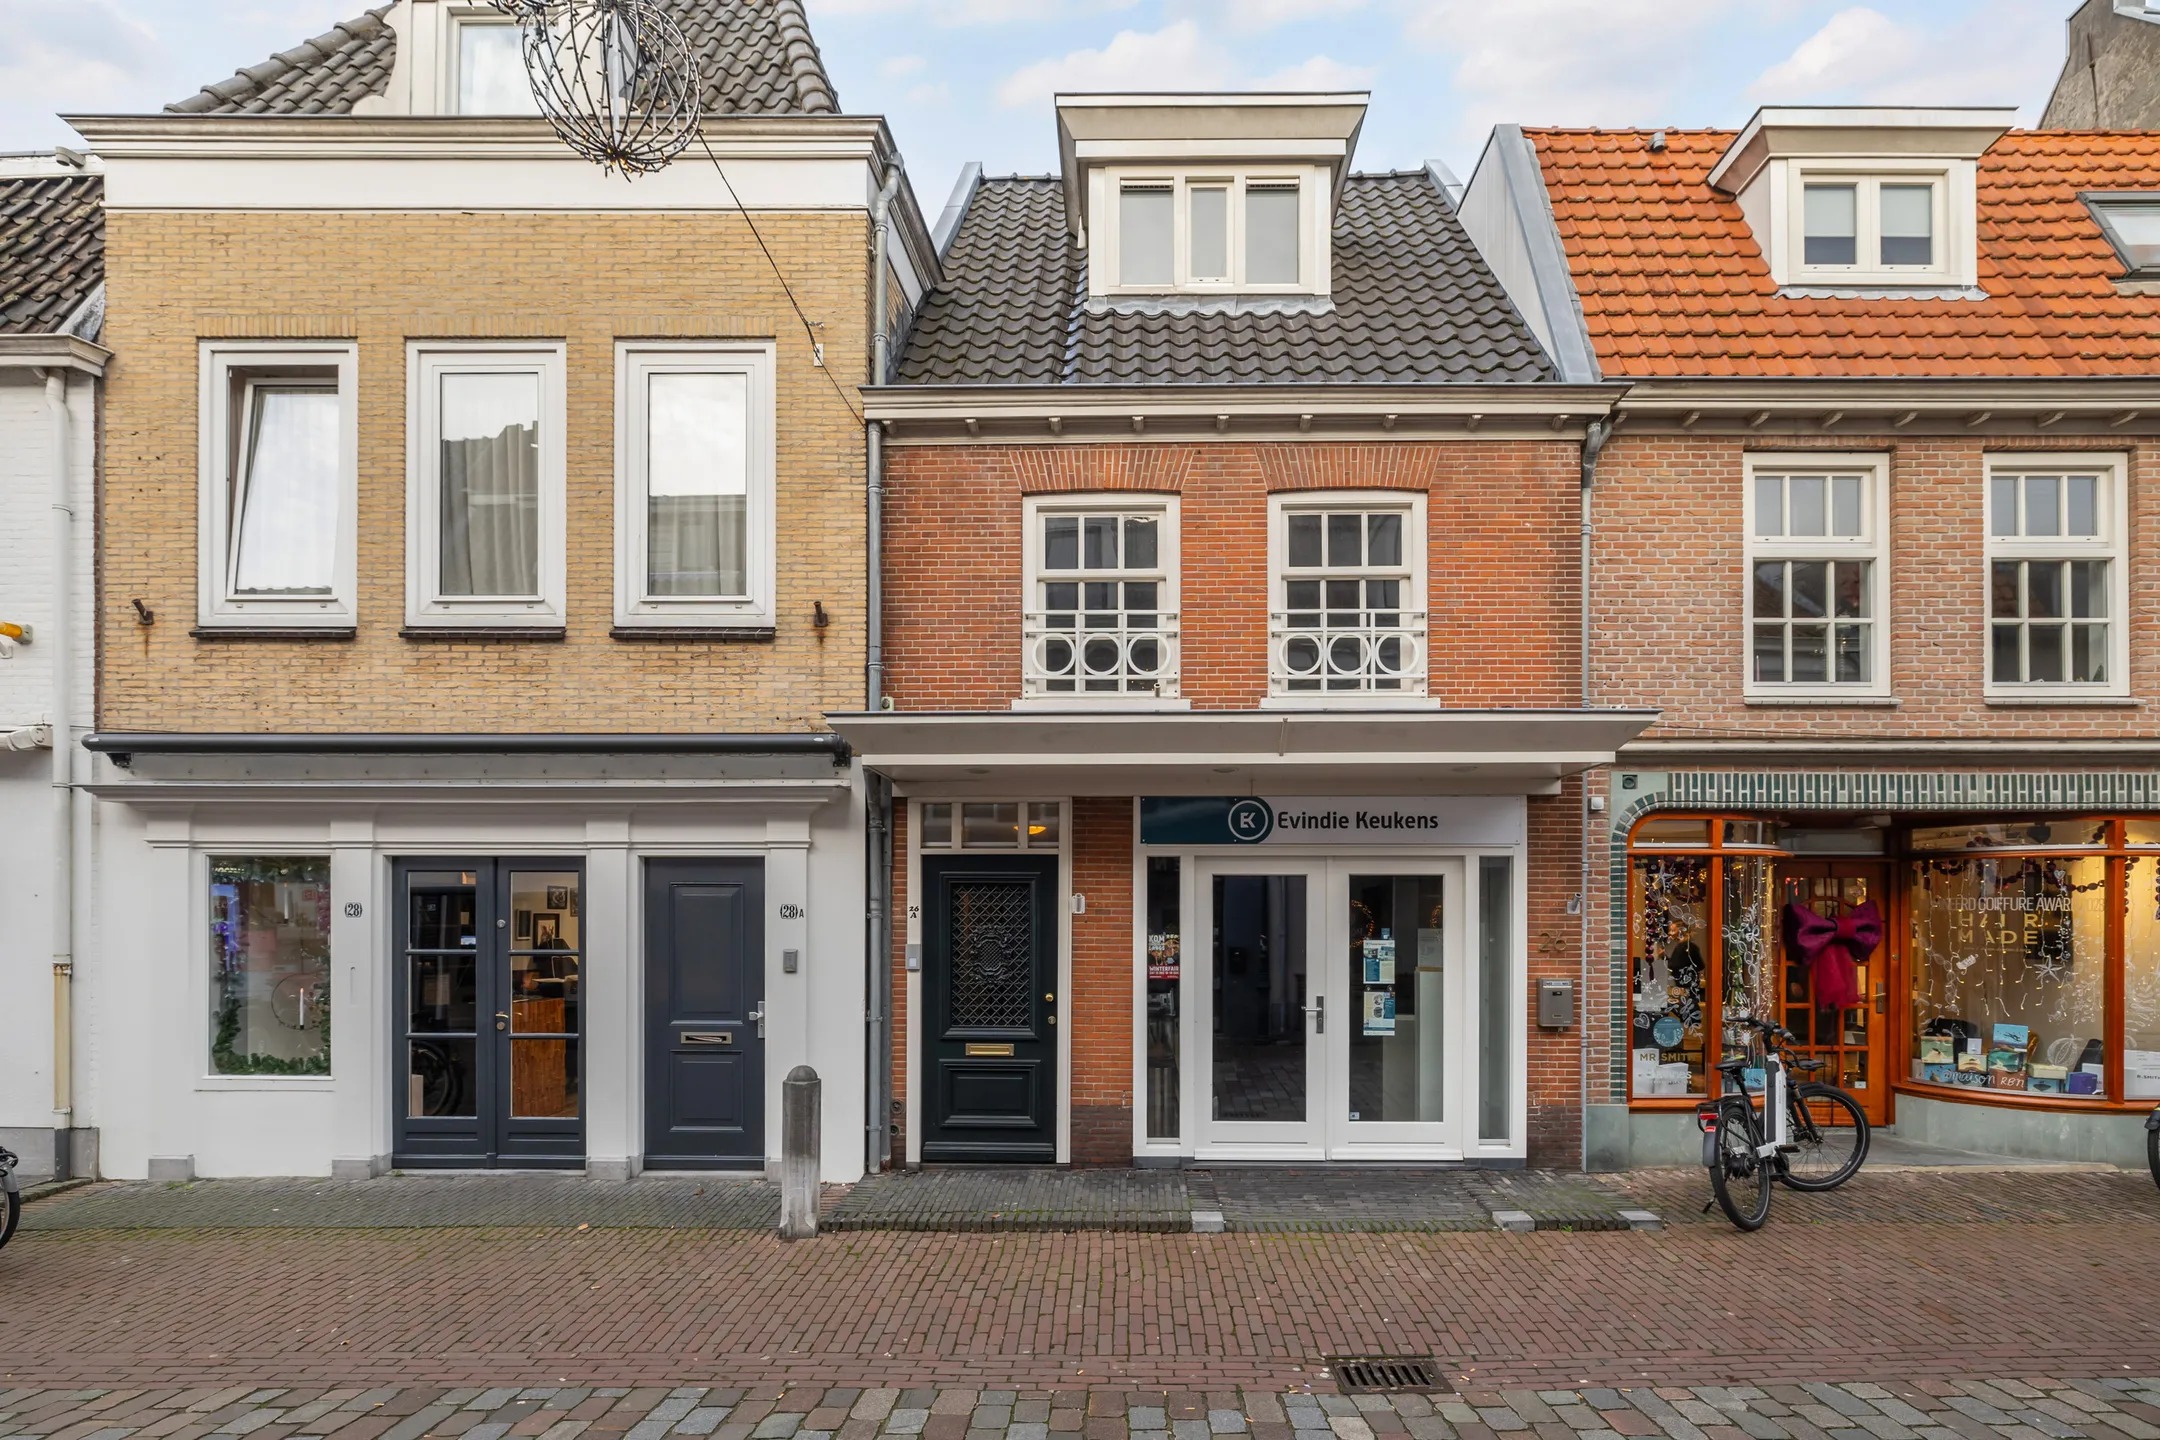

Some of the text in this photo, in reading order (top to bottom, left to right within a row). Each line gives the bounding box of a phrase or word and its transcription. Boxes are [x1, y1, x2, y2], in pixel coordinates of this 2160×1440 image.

[1277, 811, 1439, 829] Evindie Keukens
[347, 903, 360, 917] 28
[782, 905, 796, 918] 28
[1959, 913, 2038, 927] HAIR
[1539, 930, 1567, 951] 26
[1959, 930, 2038, 944] MADE
[1640, 1053, 1656, 1061] MR
